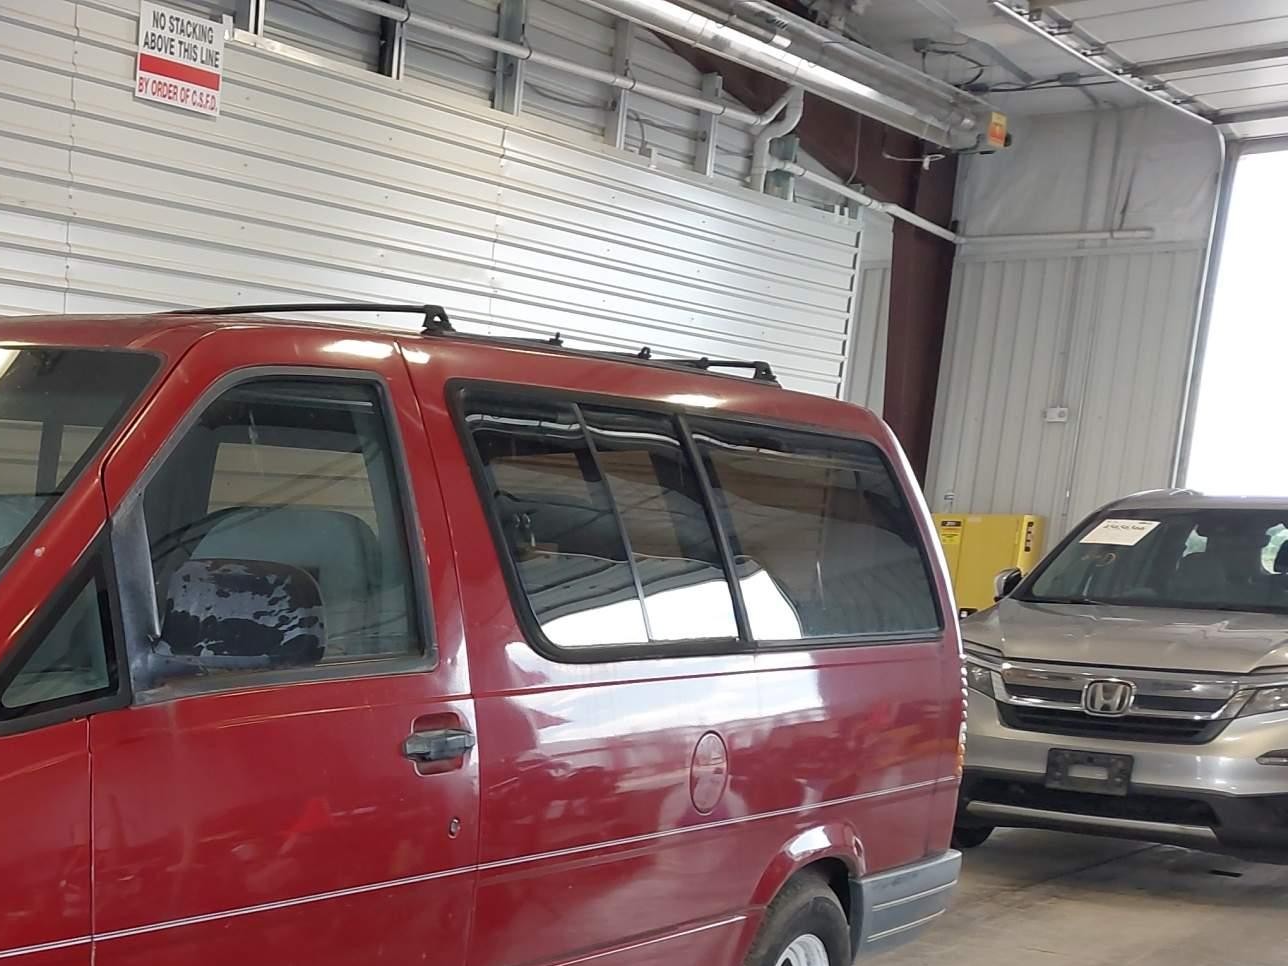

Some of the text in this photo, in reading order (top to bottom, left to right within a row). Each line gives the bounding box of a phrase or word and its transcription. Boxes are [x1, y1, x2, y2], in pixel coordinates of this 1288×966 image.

[152, 10, 214, 45] NO STACKING
[143, 31, 220, 68] ABOVE THIS LINE
[138, 76, 150, 95] BY
[151, 79, 178, 101] ORDER
[179, 86, 191, 105] OF
